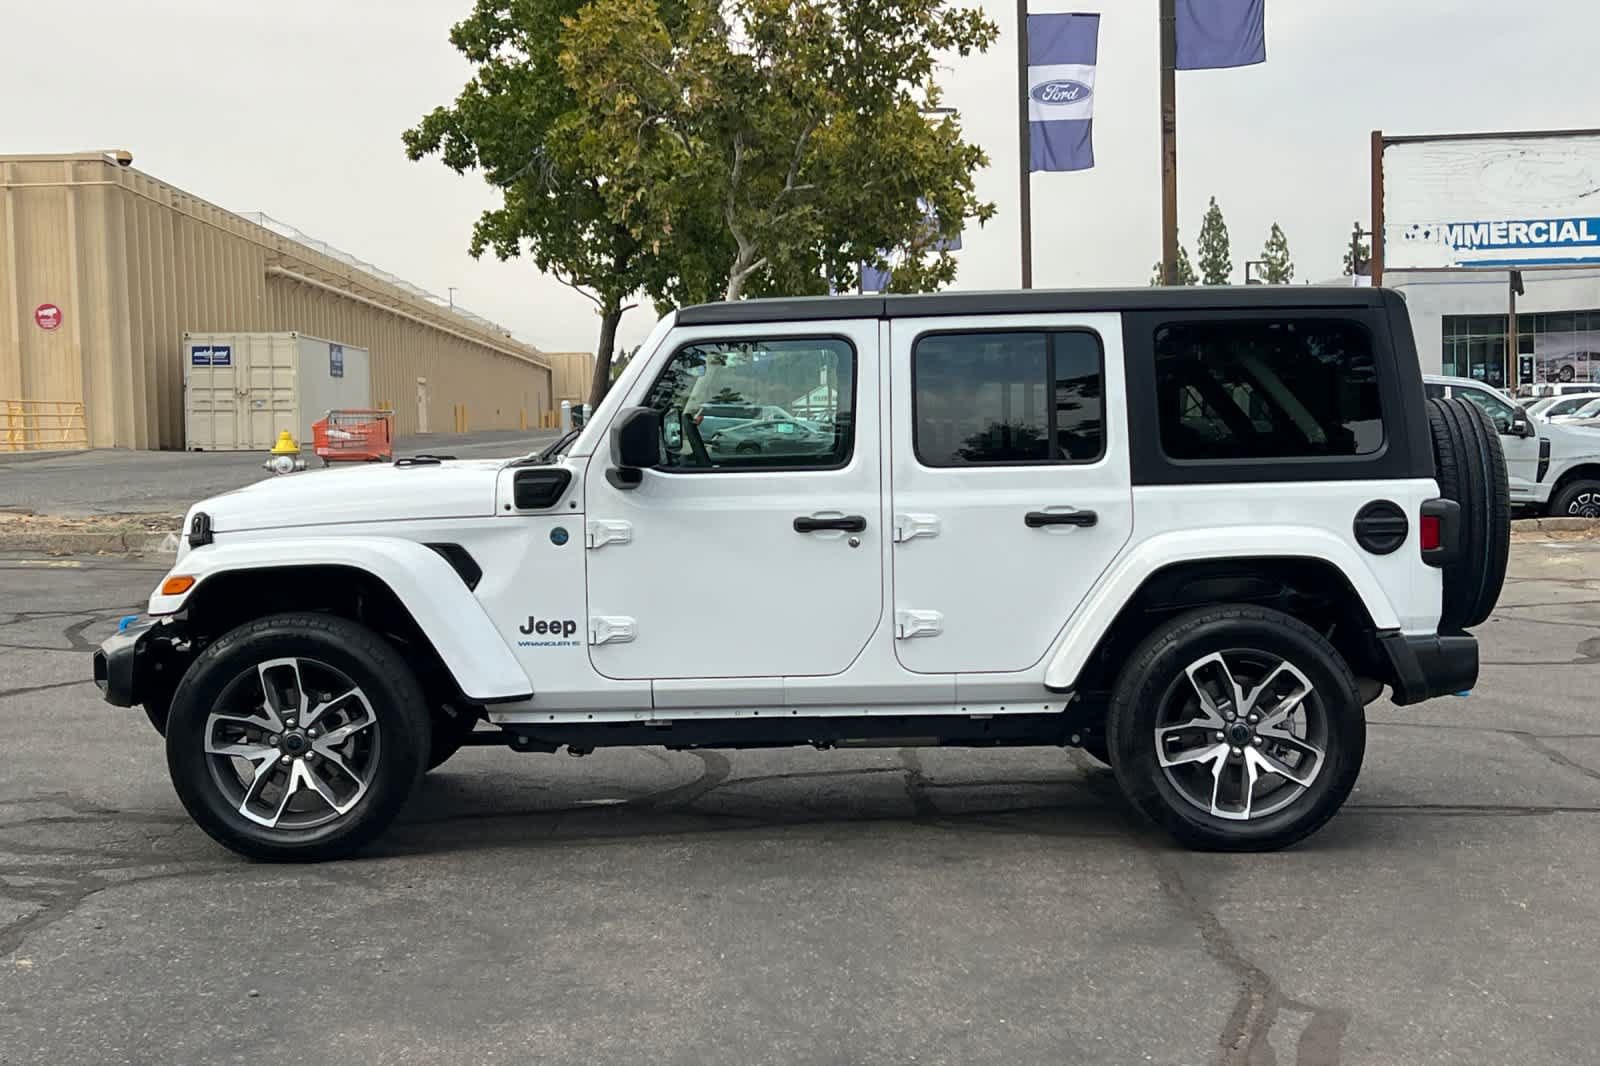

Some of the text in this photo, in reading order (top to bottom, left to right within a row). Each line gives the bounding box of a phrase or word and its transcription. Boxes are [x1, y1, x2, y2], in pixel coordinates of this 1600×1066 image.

[1042, 84, 1079, 100] Ford
[1403, 220, 1598, 247] MMERCIAL
[519, 615, 577, 638] Jeep
